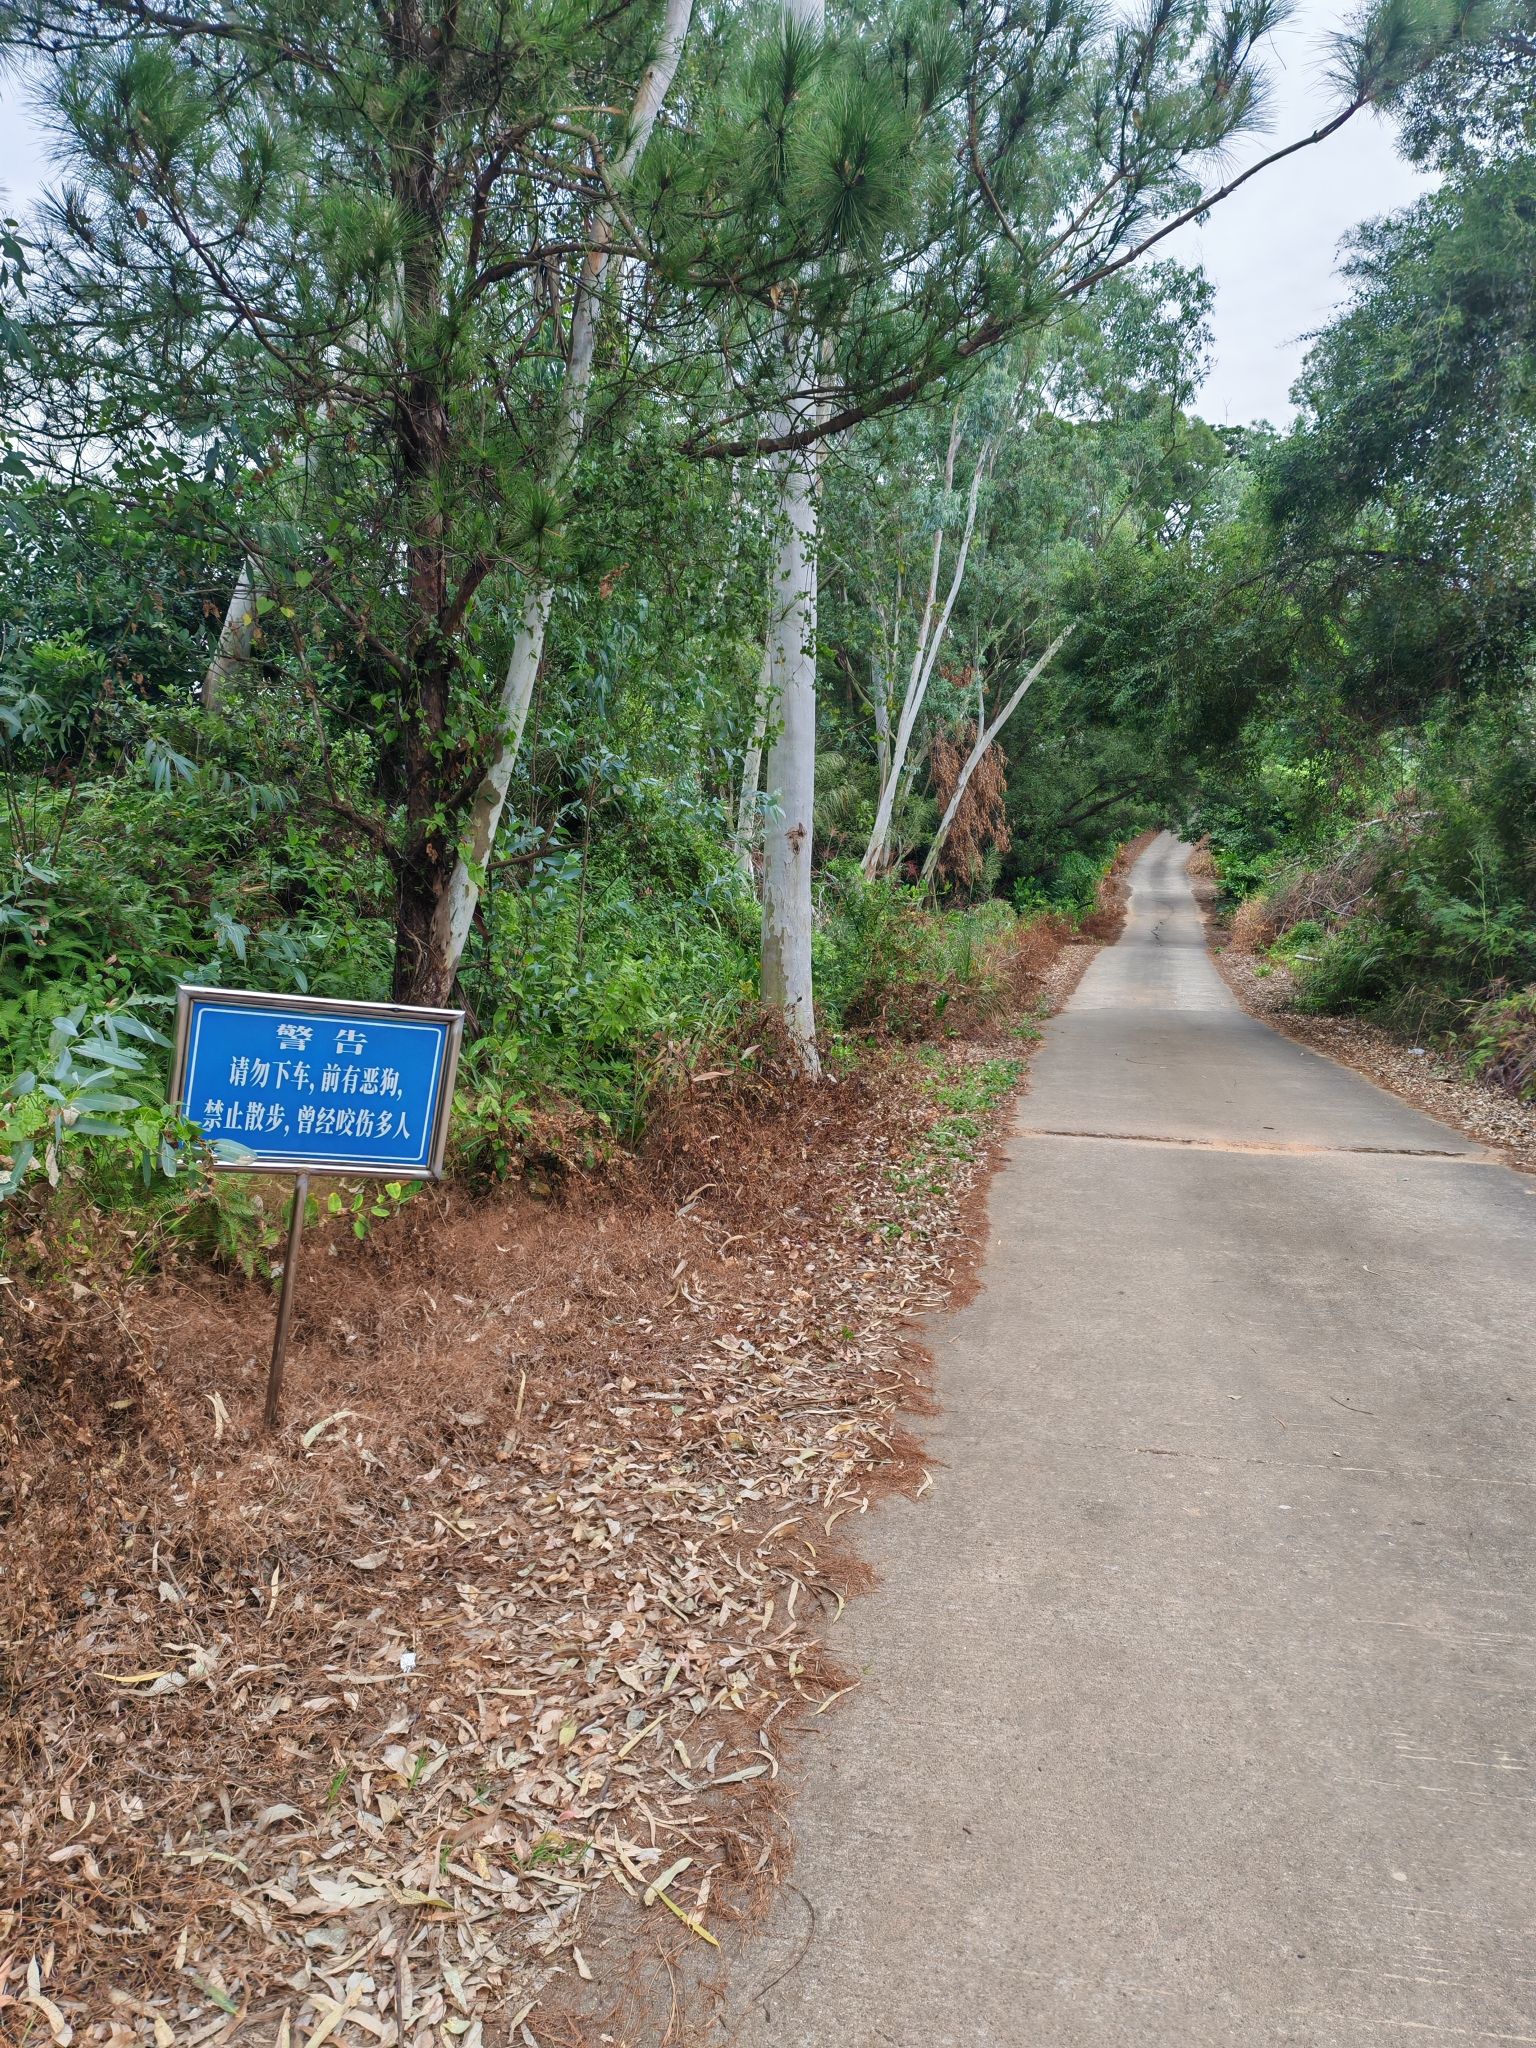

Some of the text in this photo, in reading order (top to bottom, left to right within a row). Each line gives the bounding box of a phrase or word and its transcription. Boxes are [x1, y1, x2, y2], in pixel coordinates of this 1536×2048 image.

[276, 1023, 368, 1056] 警告
[229, 1055, 403, 1101] 请勿下车，前有恶狗，
[202, 1098, 411, 1140] 禁止散步，曾经咬伤多人
